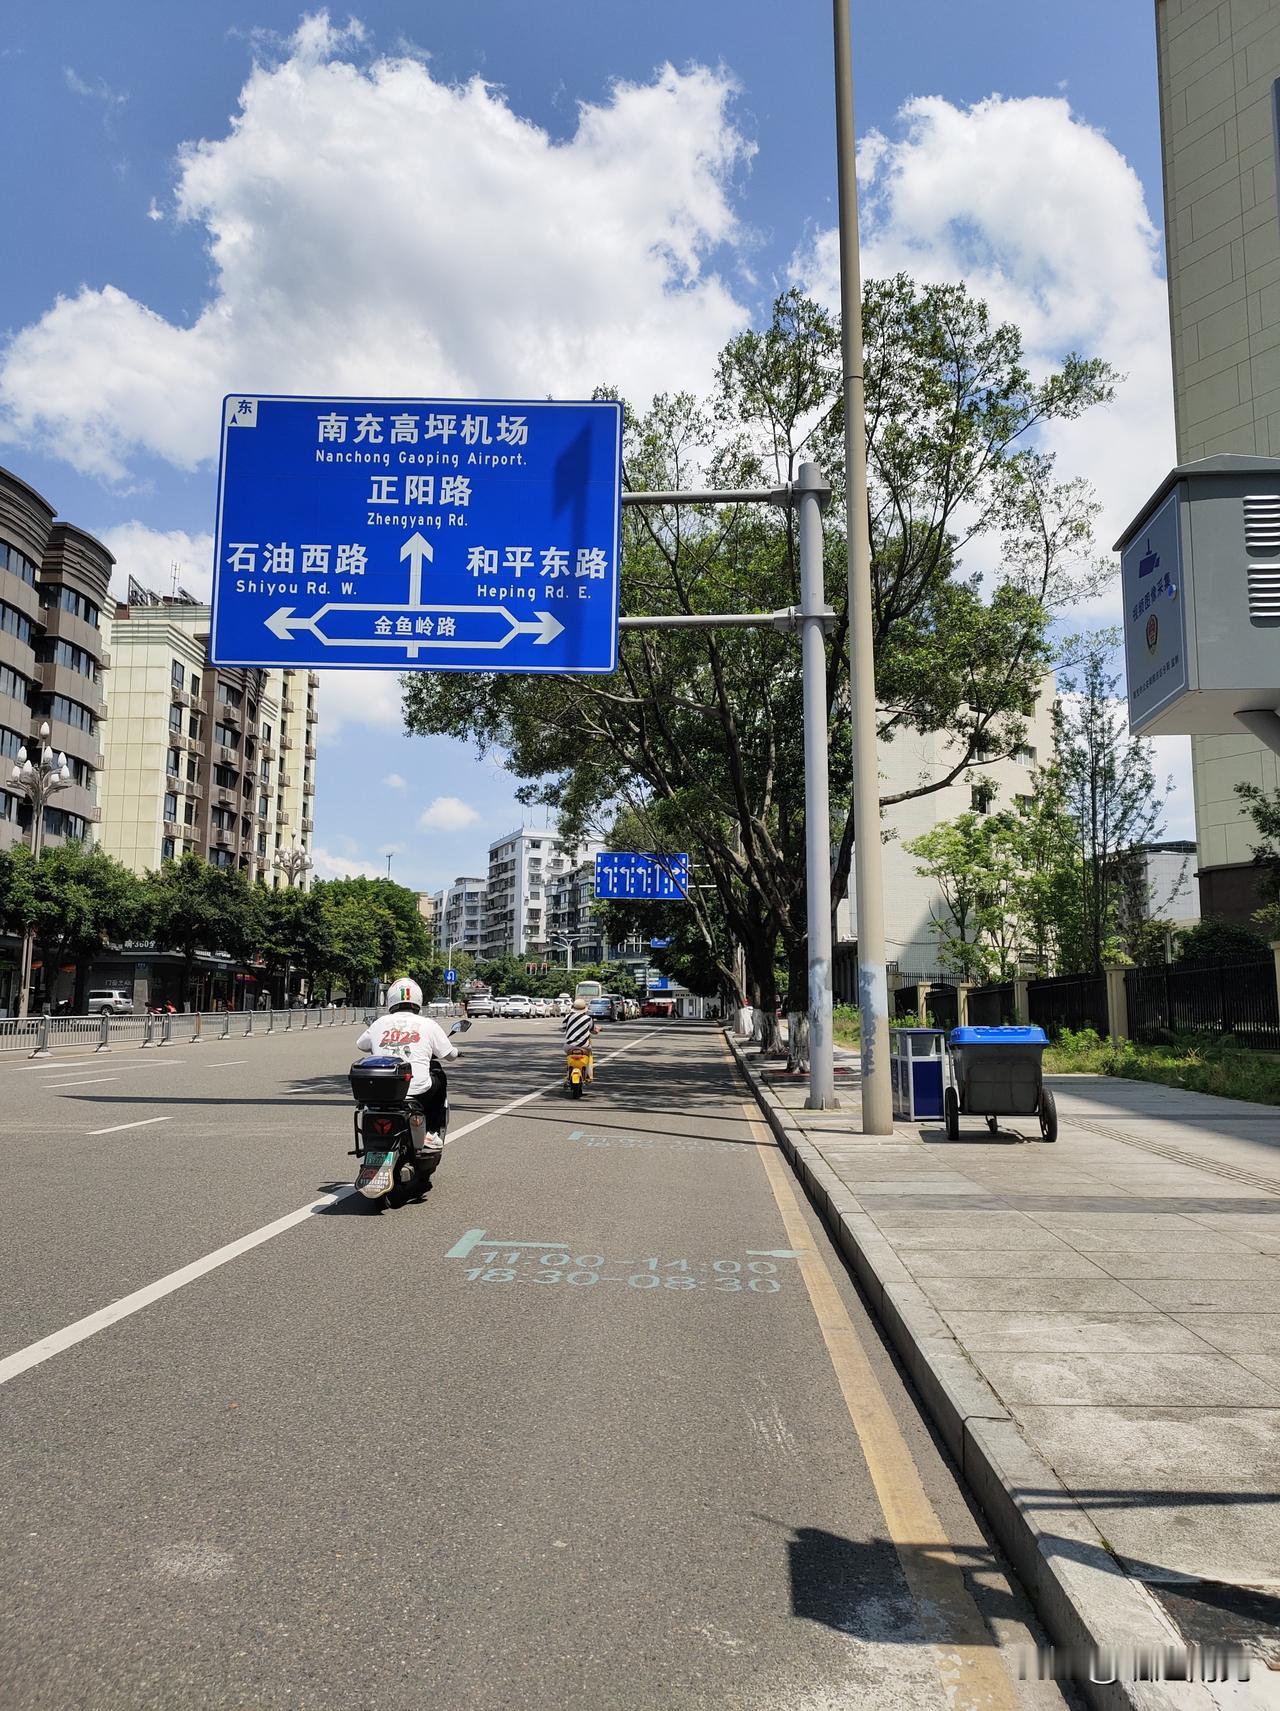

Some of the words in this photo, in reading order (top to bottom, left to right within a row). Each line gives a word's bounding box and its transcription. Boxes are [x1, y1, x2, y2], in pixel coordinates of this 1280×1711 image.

[238, 399, 253, 415] 东
[317, 412, 529, 446] 南充高坪机场
[315, 449, 390, 467] Nanchong
[398, 451, 460, 468] Gaoping
[467, 452, 527, 468] Airport.
[366, 474, 473, 507] 正阳路
[366, 512, 442, 530] Zhengyang
[447, 513, 468, 527] Rd.
[226, 542, 369, 575] 石油西路
[465, 545, 609, 580] 和平东路
[235, 579, 298, 596] Shiyou
[306, 581, 330, 595] Rd.
[341, 581, 357, 595] W.
[476, 584, 536, 602] Heping
[544, 585, 569, 599] Rd.
[578, 585, 592, 599] E.
[373, 615, 457, 637] 金鱼岭路
